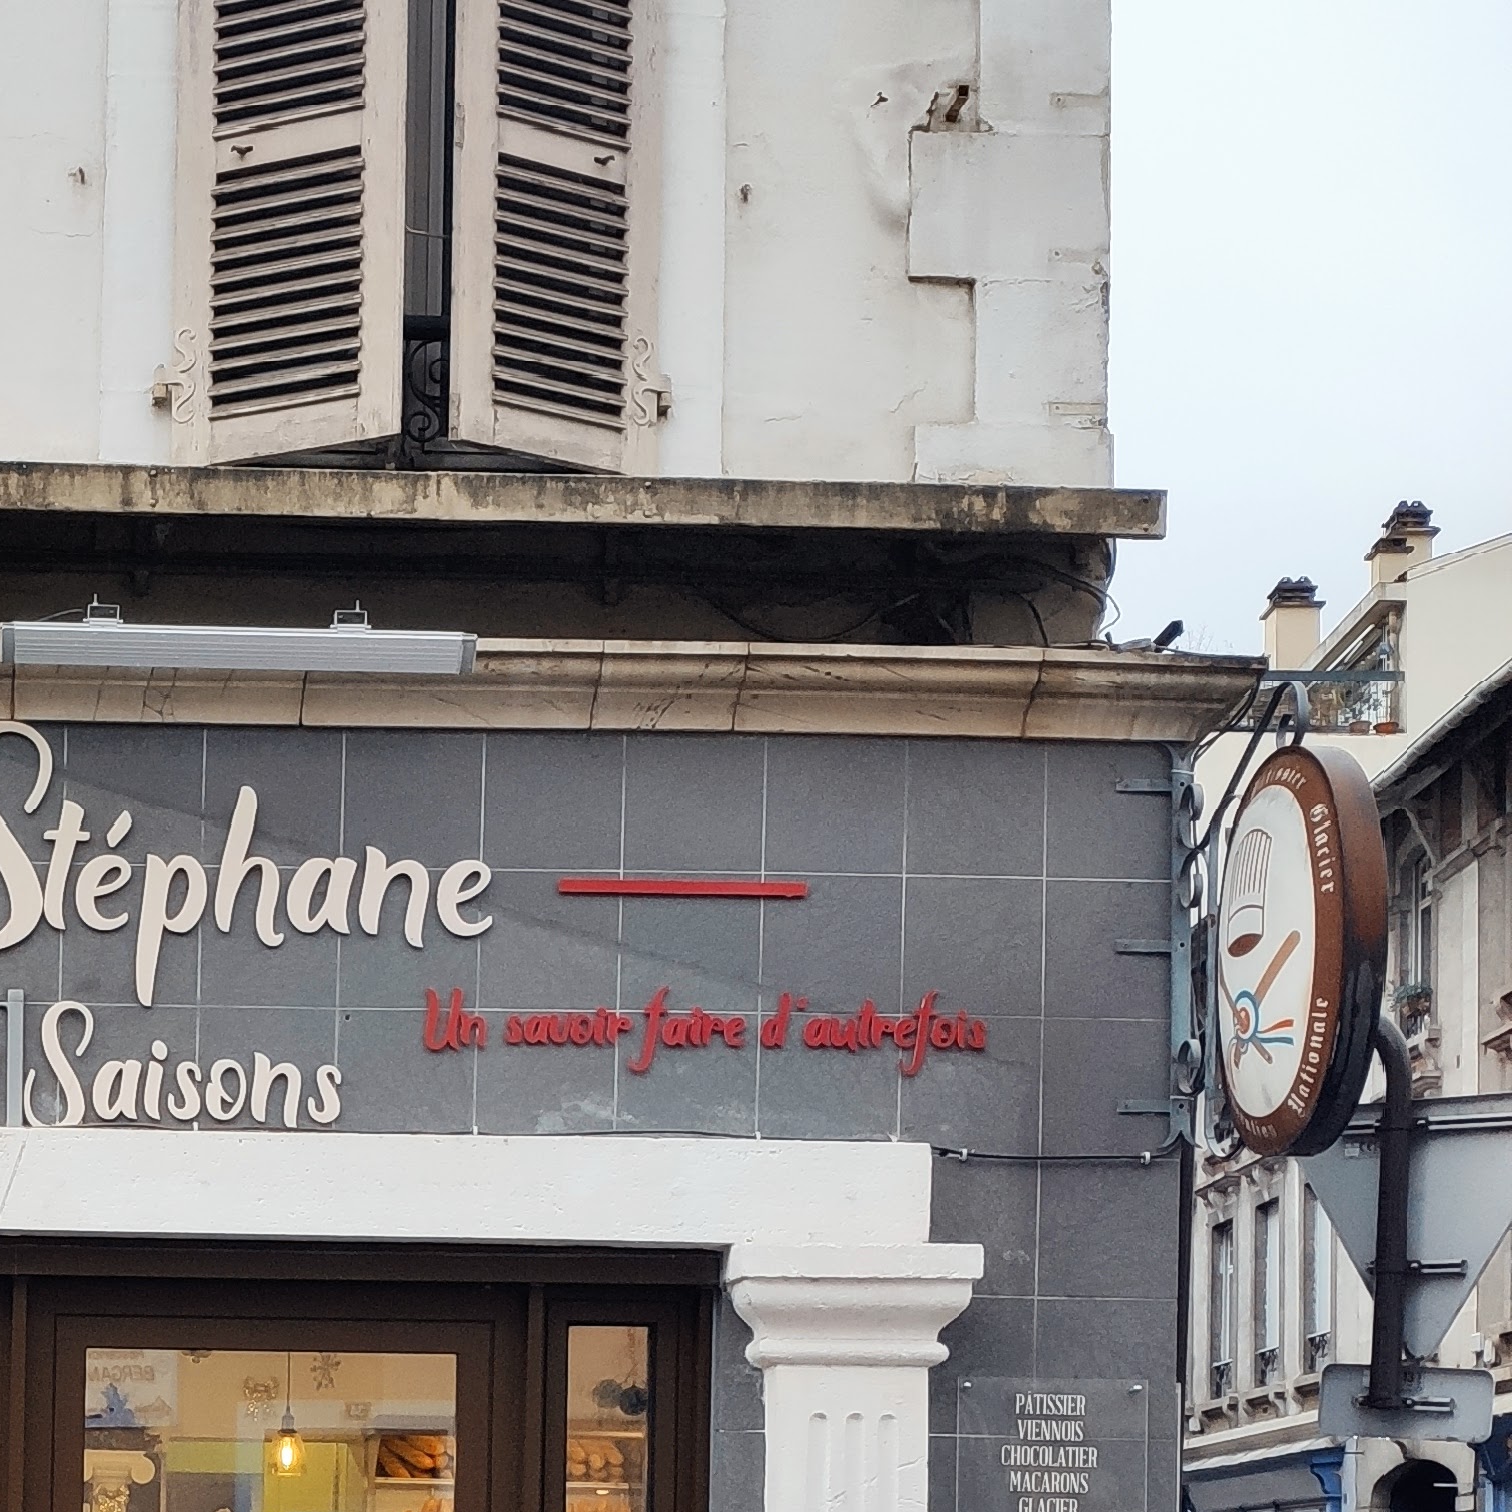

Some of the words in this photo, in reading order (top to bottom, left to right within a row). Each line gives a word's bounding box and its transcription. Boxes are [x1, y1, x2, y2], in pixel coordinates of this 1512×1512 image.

[1309, 803, 1336, 893] Glacier
[425, 987, 487, 1052] Un
[504, 1007, 632, 1047] savoir
[627, 986, 747, 1075] faire
[760, 990, 986, 1077] d'autrefois
[1288, 997, 1329, 1118] Nationale
[24, 1001, 342, 1129] Saisons
[1015, 1391, 1086, 1416] PÂTISSIER
[1017, 1419, 1084, 1441] VIENNOIS
[1001, 1445, 1098, 1468] CHOCOLATIER
[1009, 1471, 1089, 1493] MACARONS
